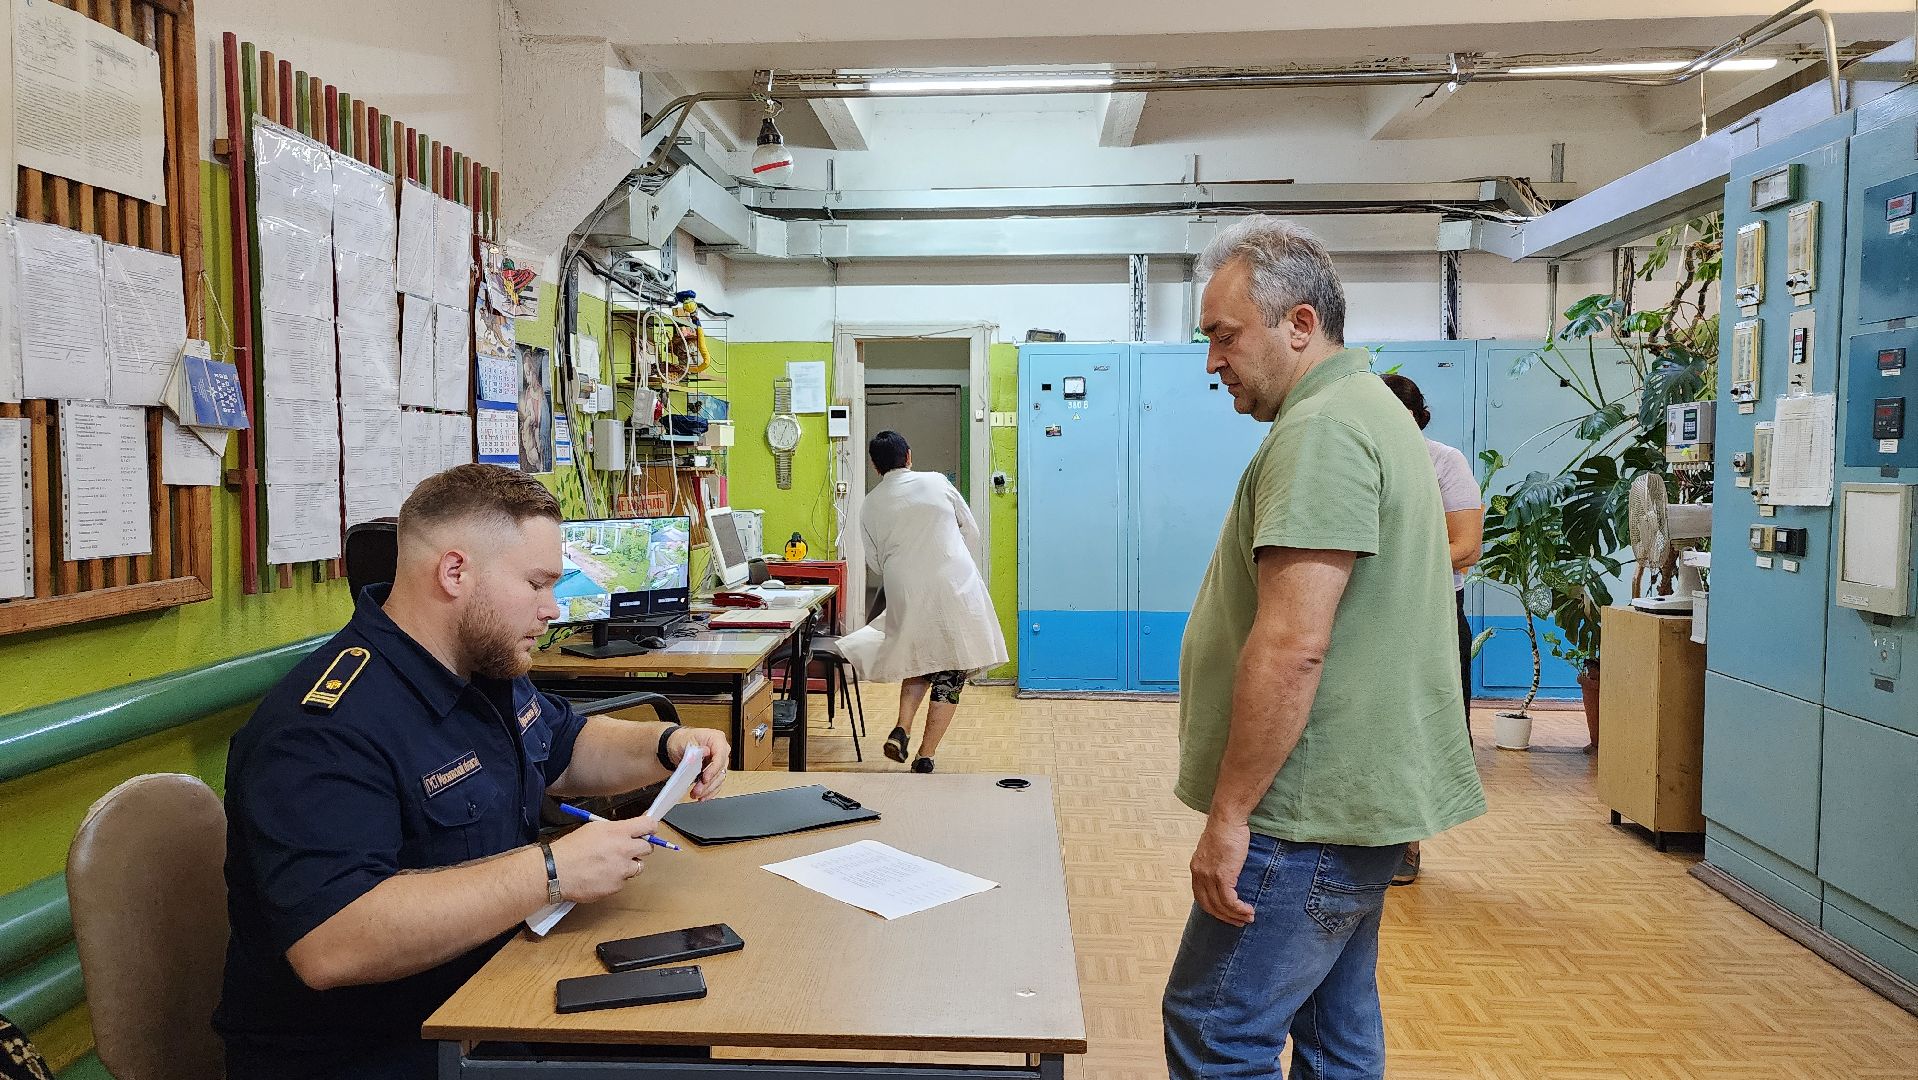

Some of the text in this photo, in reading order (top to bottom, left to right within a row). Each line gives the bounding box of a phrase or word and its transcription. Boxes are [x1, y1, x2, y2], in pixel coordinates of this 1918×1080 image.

[1067, 401, 1082, 409] 380
[1873, 637, 1895, 650] 1 2 3
